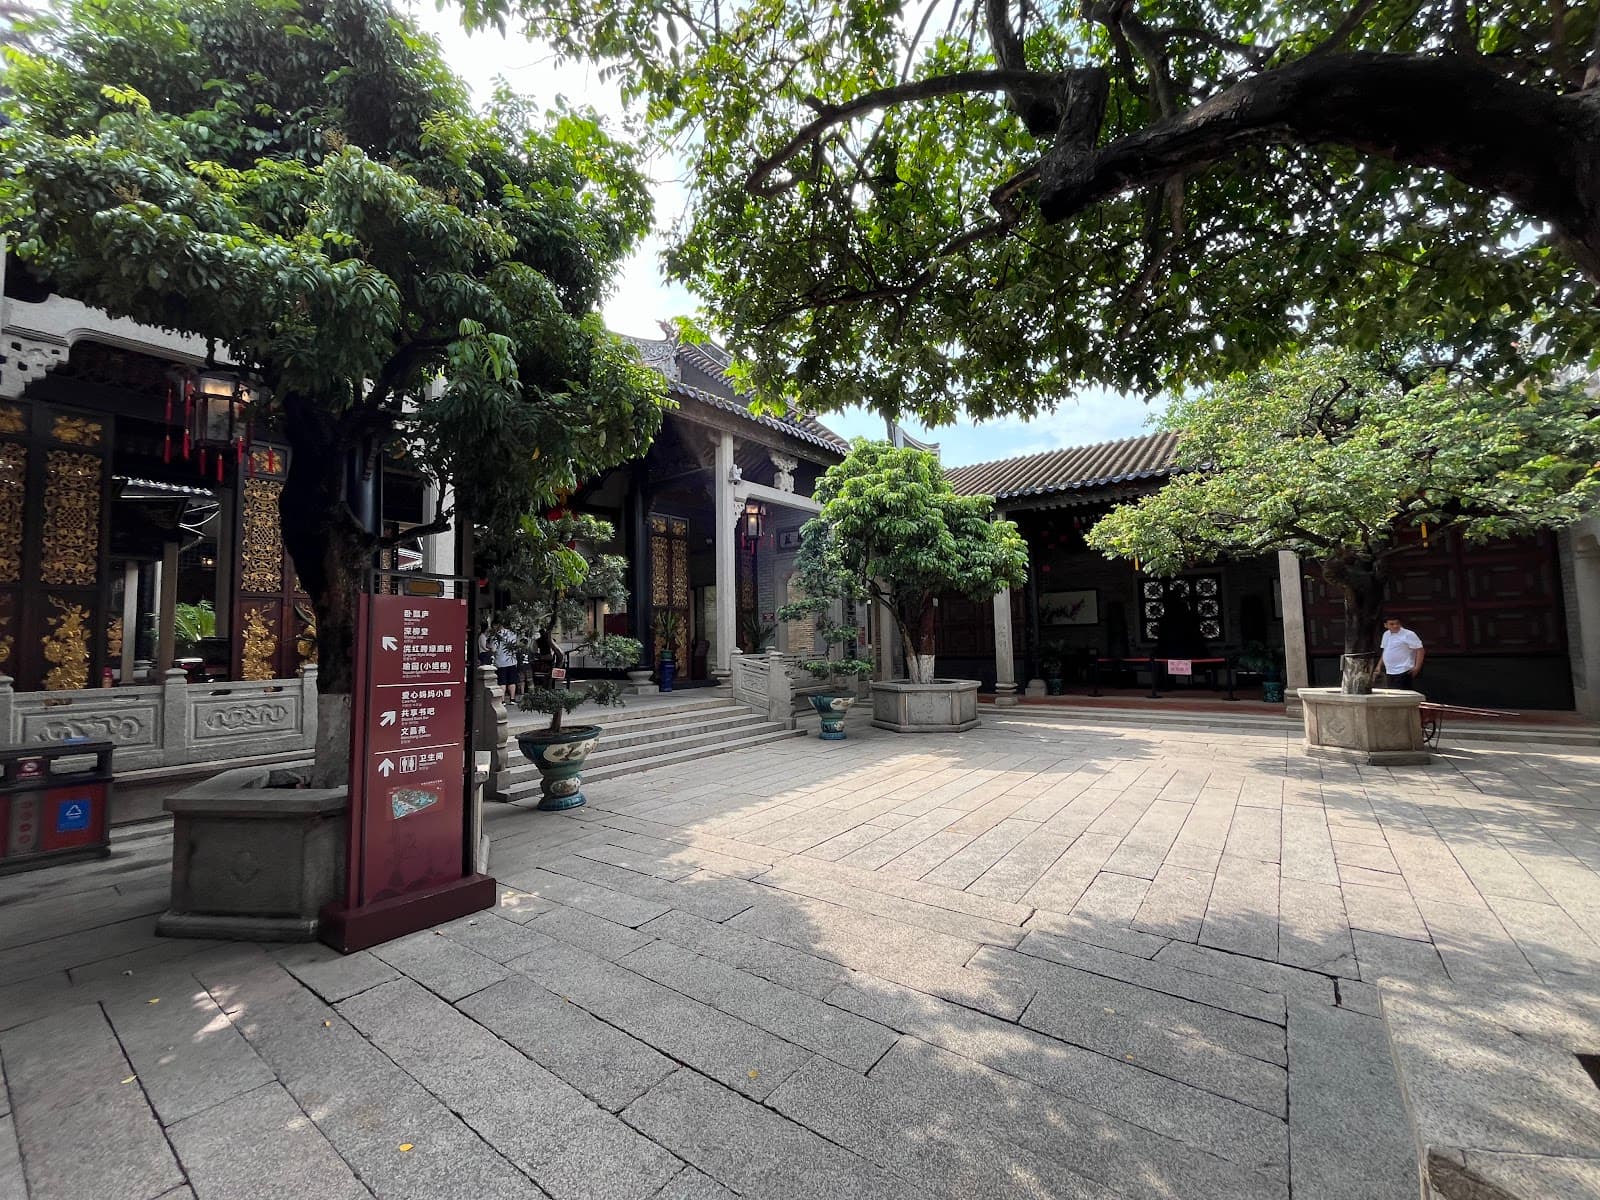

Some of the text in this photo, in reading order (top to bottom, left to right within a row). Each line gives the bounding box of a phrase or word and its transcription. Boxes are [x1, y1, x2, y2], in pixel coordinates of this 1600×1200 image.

[401, 689, 452, 699] 爱心妈妈小屋
[401, 707, 435, 717] 共享书吧
[418, 752, 444, 762] 卫生间
